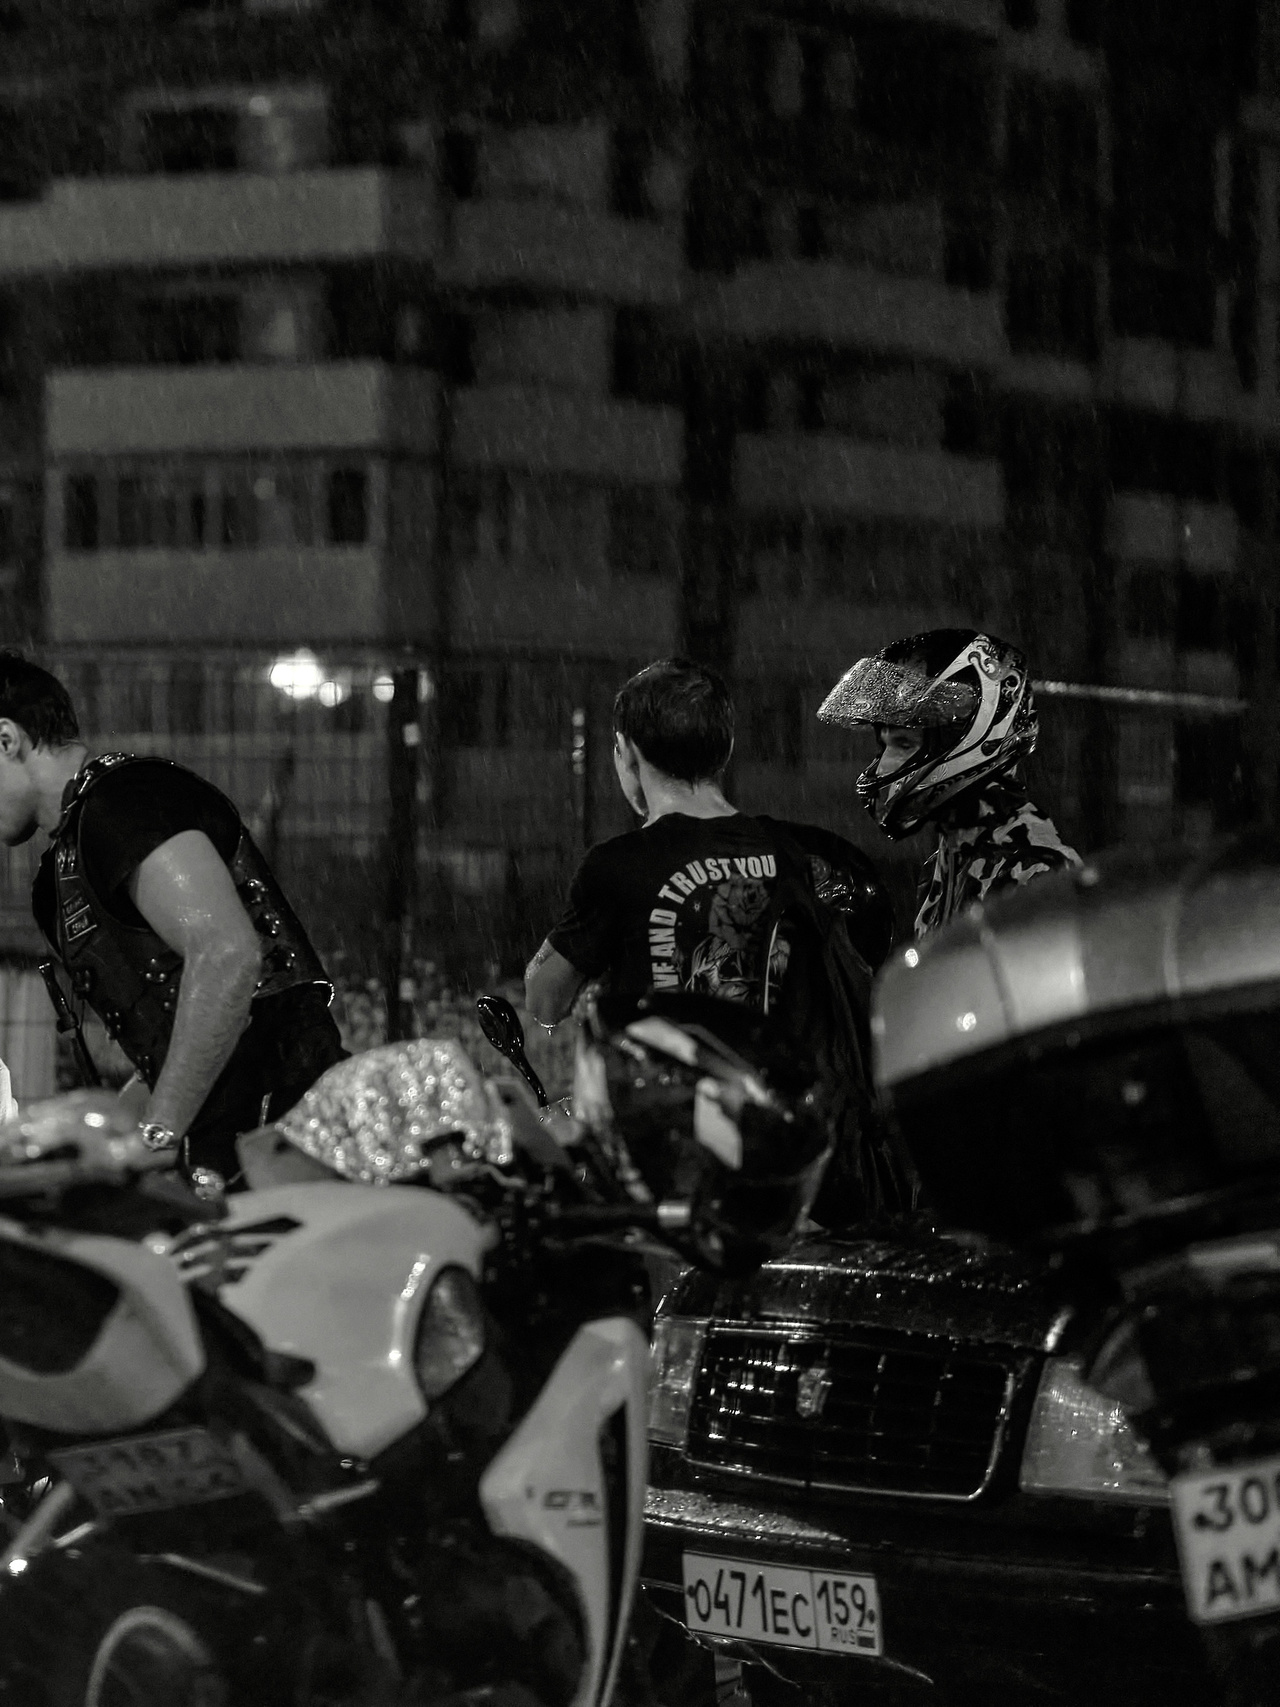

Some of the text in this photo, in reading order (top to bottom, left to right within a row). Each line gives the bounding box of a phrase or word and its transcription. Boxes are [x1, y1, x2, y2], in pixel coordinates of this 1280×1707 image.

[658, 857, 731, 905] TRUST
[733, 855, 777, 878] YOU
[648, 908, 677, 957] AND
[1196, 1466, 1280, 1533] 30
[817, 1580, 867, 1628] 159
[831, 1626, 856, 1646] RUS
